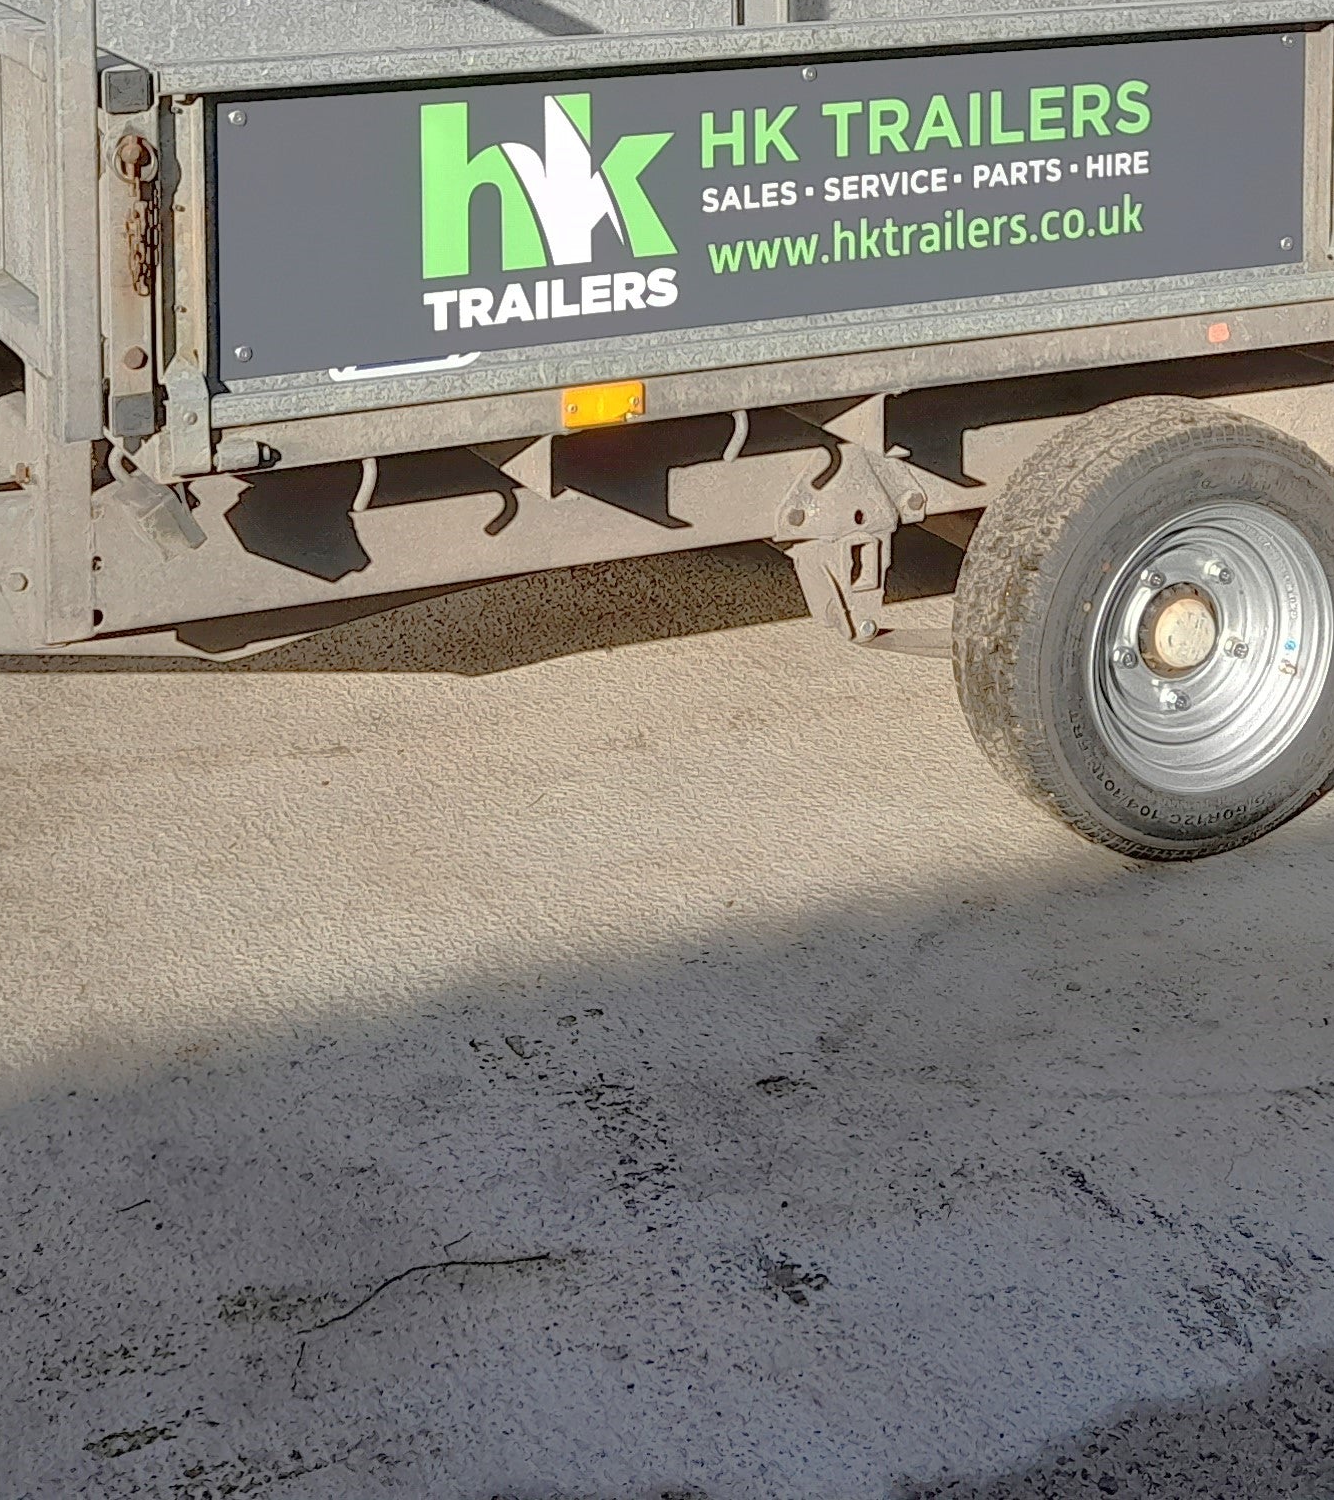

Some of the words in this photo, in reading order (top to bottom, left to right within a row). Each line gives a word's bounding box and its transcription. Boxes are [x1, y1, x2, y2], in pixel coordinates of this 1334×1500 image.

[700, 106, 800, 169] HK
[822, 80, 1152, 158] TRAILERS
[420, 92, 679, 280] hk
[702, 181, 797, 213] SALES
[824, 167, 948, 202] SERVICE
[973, 158, 1062, 189] PARTS
[1086, 150, 1150, 179] HIRE
[708, 193, 1143, 274] www.hktrailers.co.uk
[423, 267, 679, 332] TRAILERS
